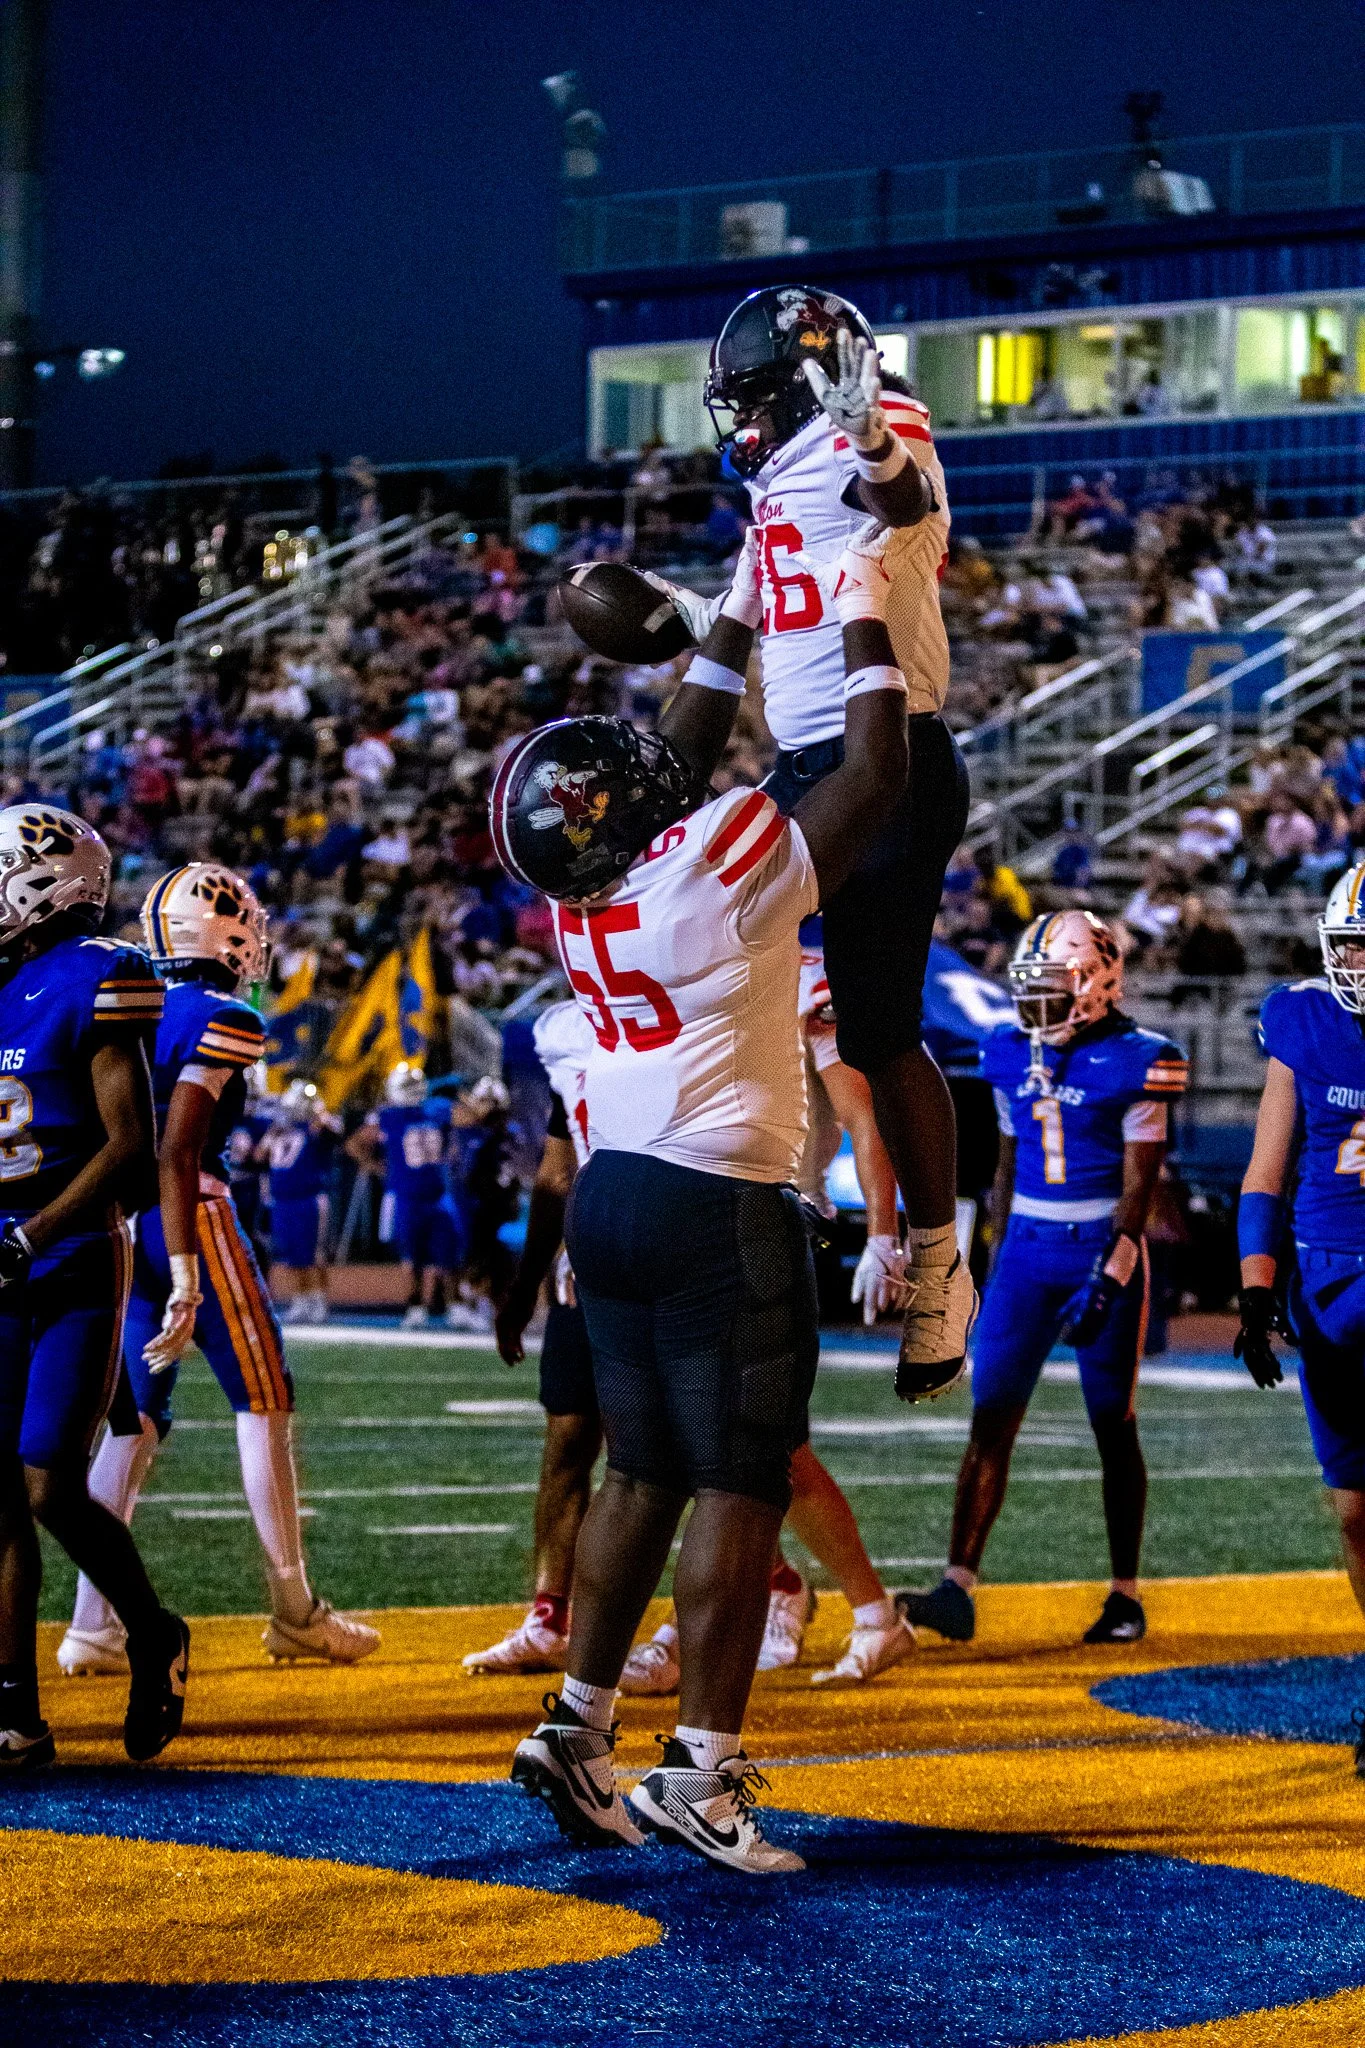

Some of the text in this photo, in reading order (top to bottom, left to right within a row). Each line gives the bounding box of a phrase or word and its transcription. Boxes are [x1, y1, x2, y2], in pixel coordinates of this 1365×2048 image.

[558, 901, 684, 1053] 55
[0, 1047, 27, 1071] RS
[1032, 1097, 1067, 1184] 1
[660, 1799, 698, 1836] FORCE
